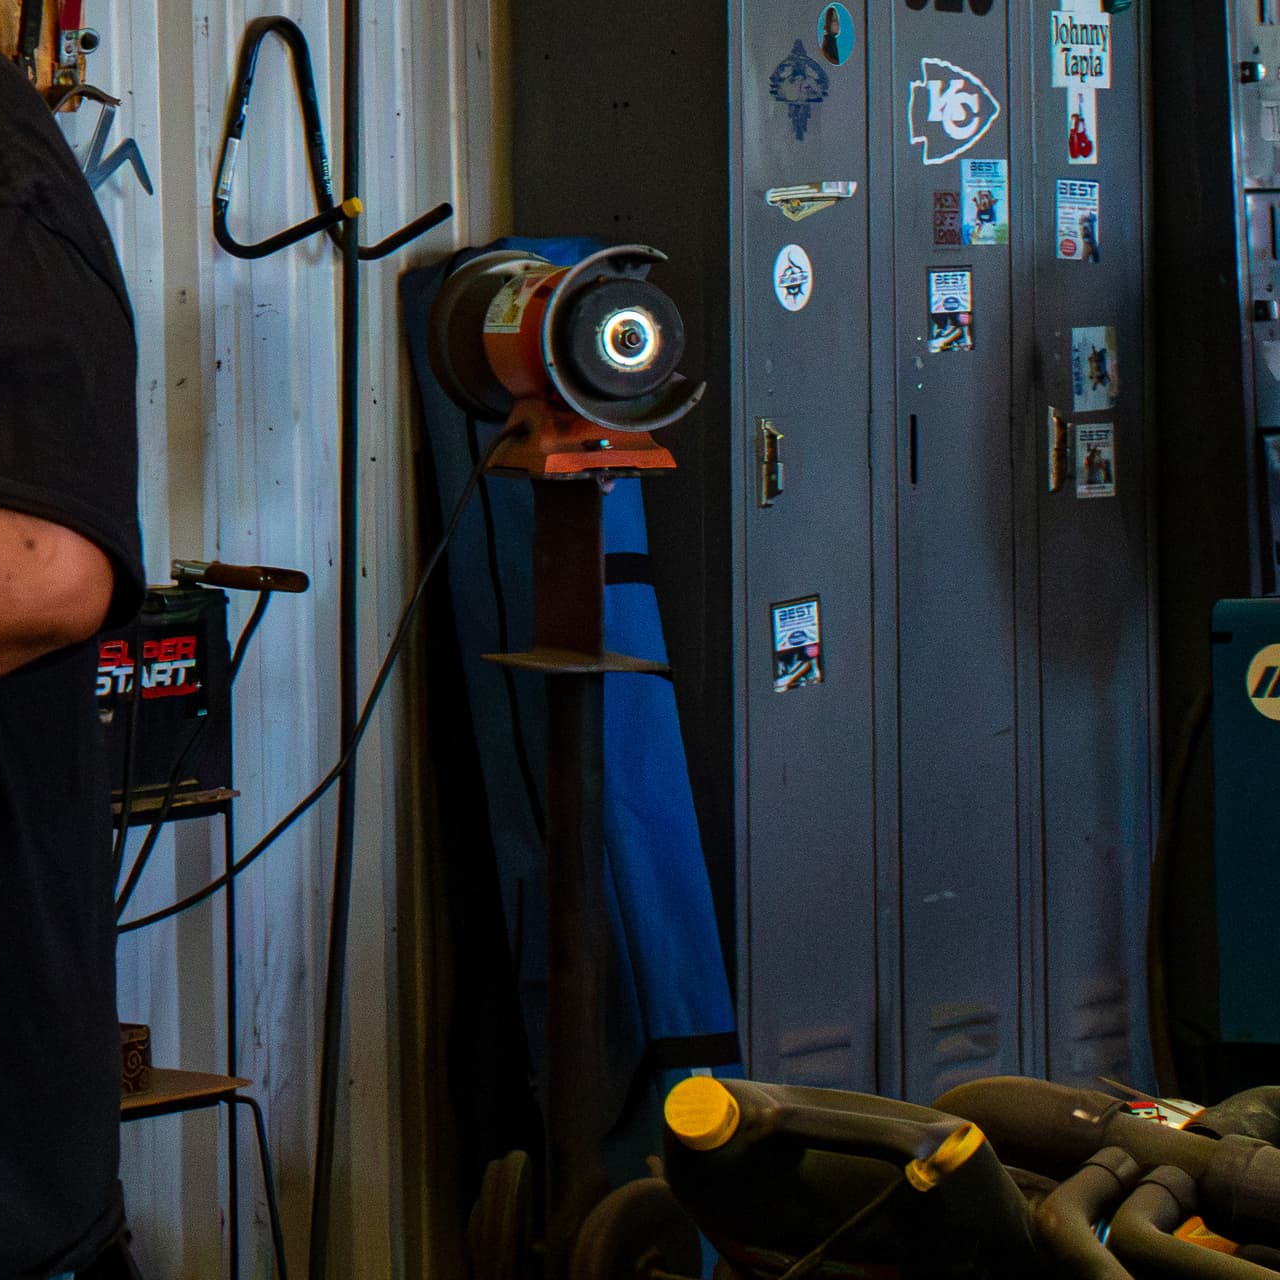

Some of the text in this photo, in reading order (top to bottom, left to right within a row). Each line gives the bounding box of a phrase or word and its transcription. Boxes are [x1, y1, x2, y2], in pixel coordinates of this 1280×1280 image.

[1053, 15, 1109, 52] Johnny
[1061, 47, 1104, 83] Tapia
[927, 79, 980, 140] KC
[970, 161, 1000, 172] BEST
[1058, 182, 1098, 201] BEST
[934, 273, 966, 285] BEST
[778, 604, 814, 621] BEST
[96, 658, 197, 696] START
